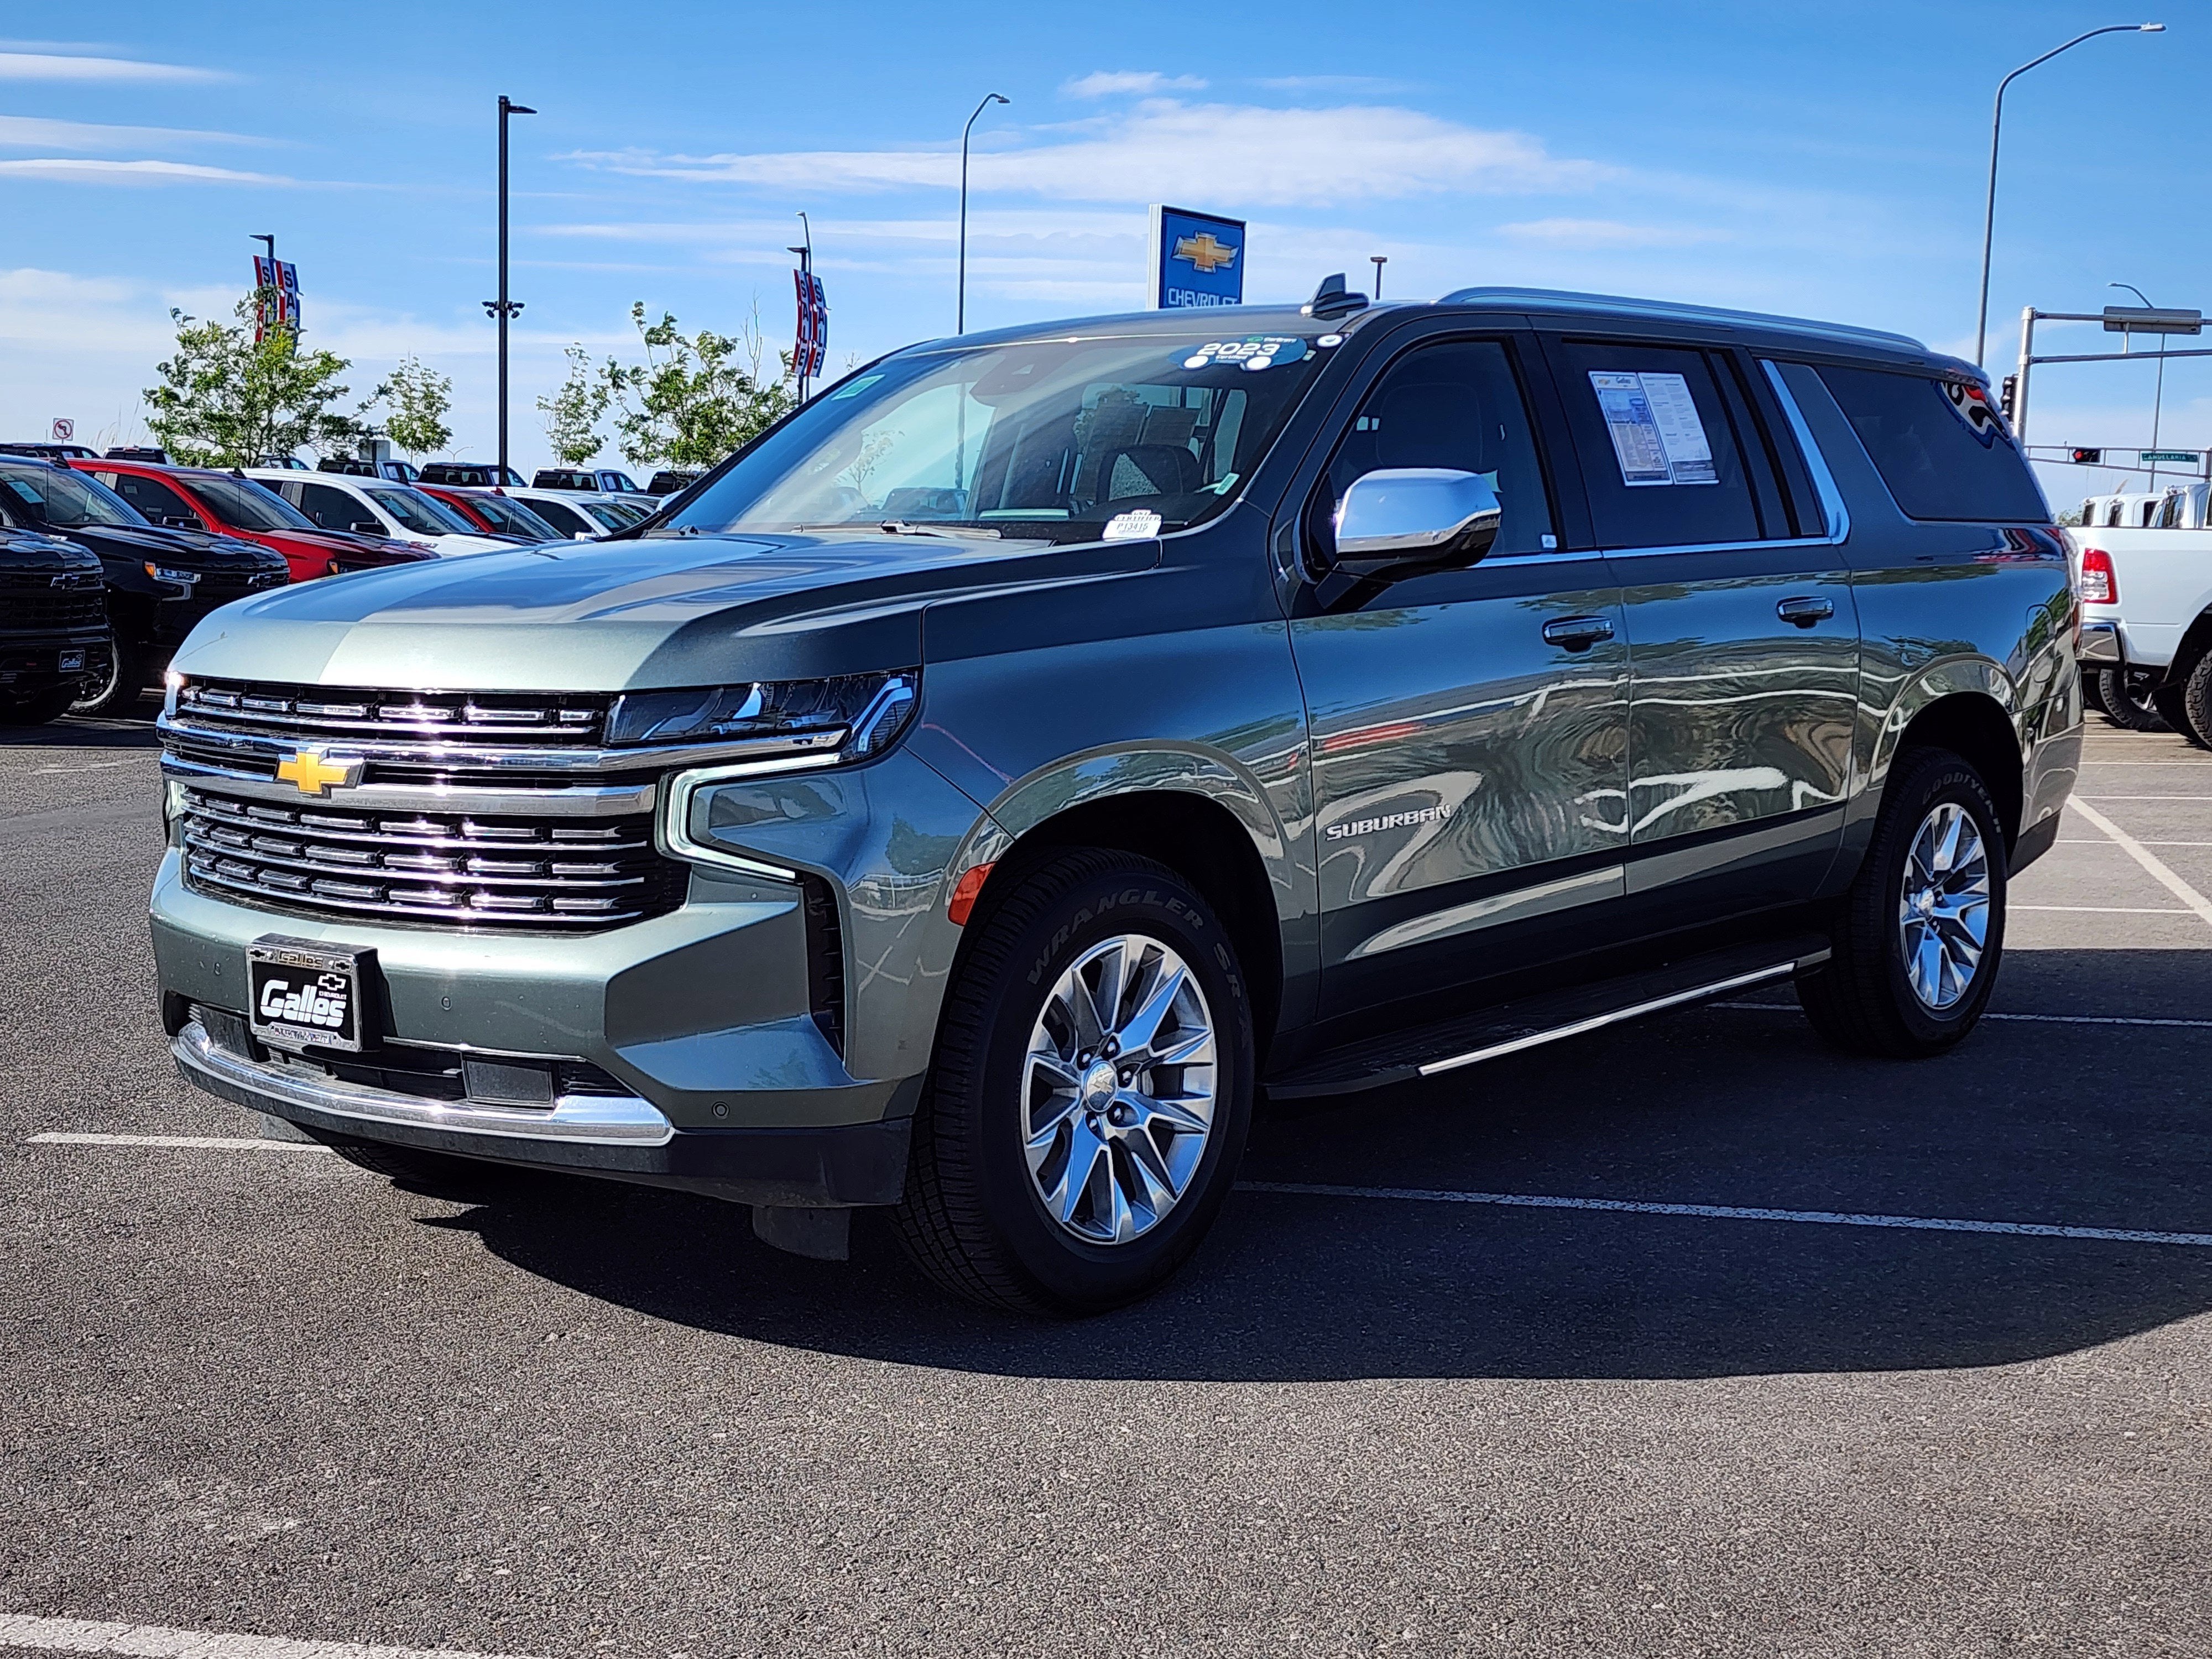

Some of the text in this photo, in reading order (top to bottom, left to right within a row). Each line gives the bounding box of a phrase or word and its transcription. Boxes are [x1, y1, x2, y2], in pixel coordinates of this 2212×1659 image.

[798, 280, 808, 366] SALE
[813, 284, 825, 369] SALE
[1197, 342, 1281, 356] 2023
[1326, 805, 1451, 841] SUBURBAN
[1027, 889, 1204, 985] WRANGLER
[260, 979, 347, 1027] Galles
